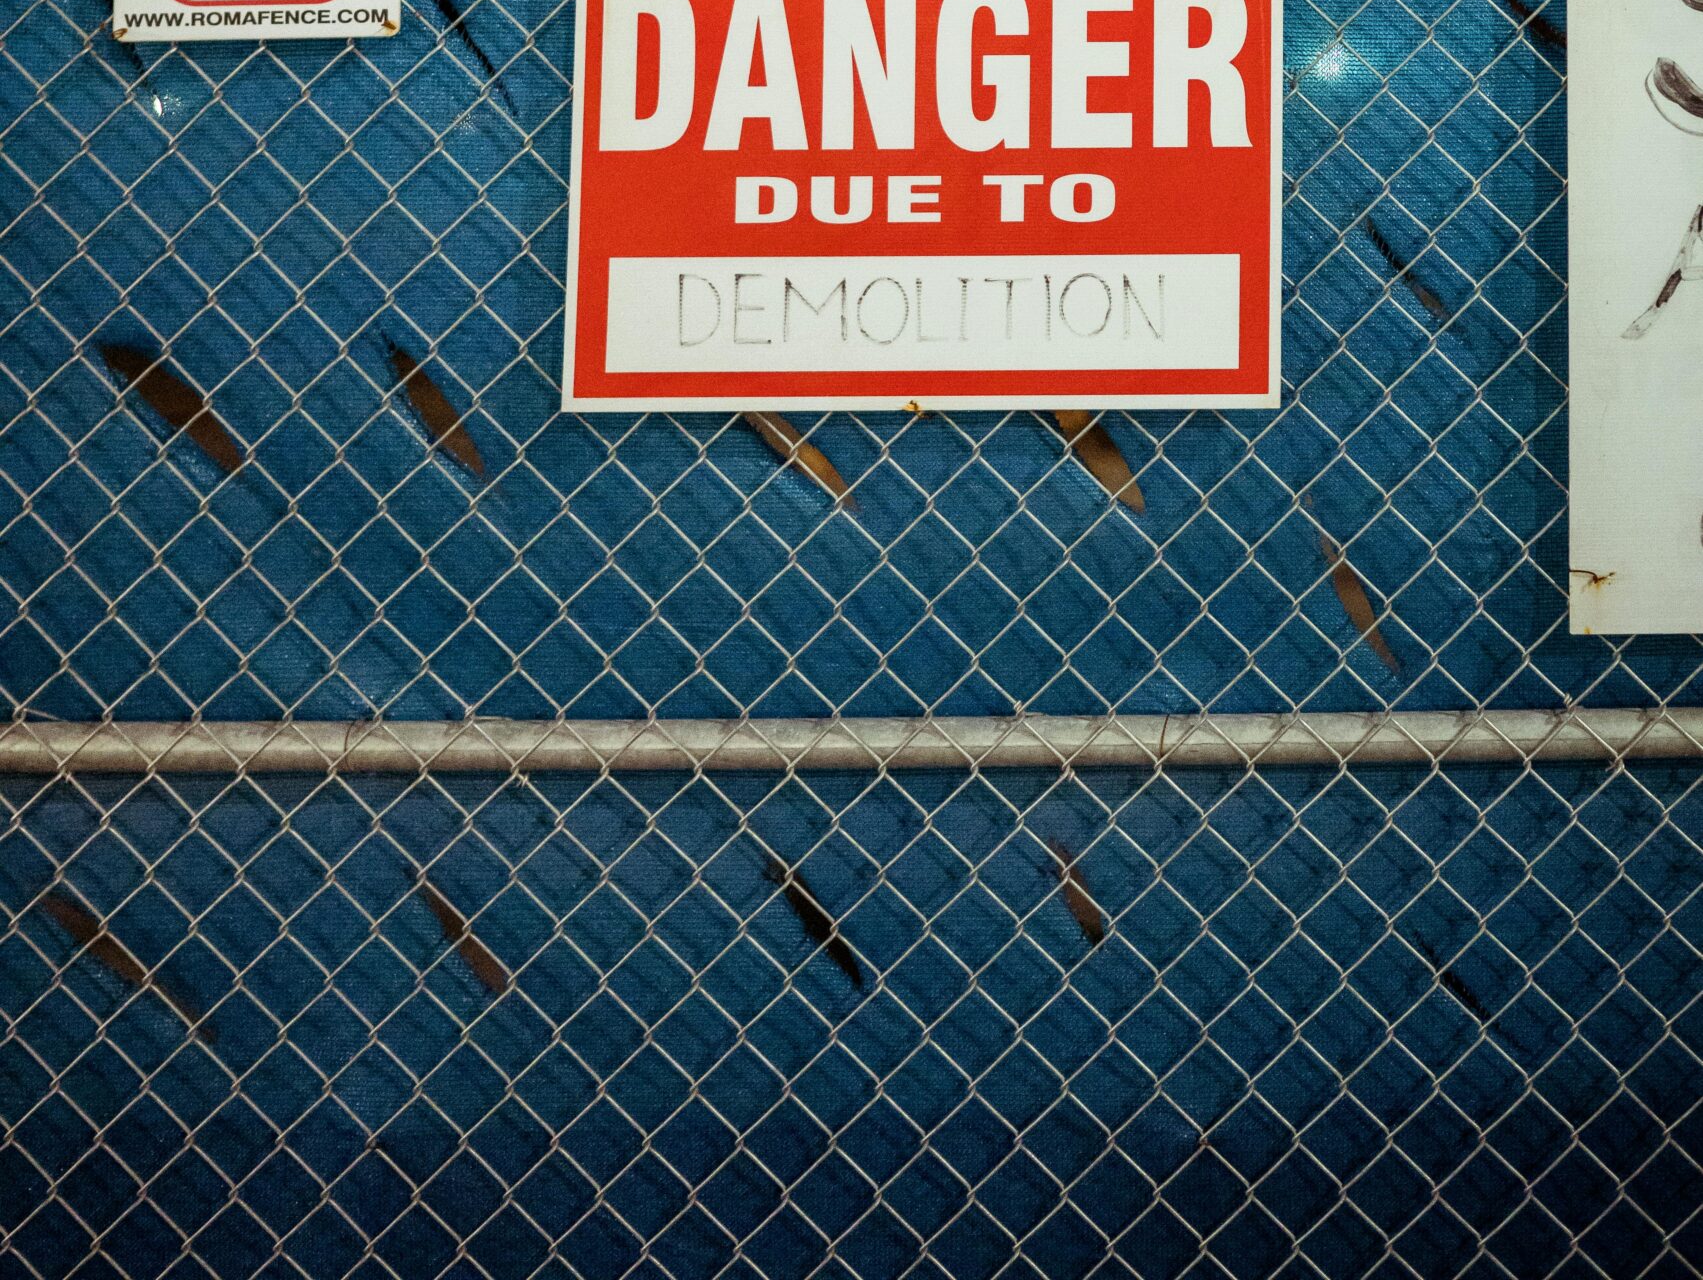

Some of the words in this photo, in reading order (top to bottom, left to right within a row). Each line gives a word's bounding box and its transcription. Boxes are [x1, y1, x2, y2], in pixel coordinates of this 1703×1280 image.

[124, 8, 389, 28] WWW.ROMAFENCE.COM
[734, 173, 942, 225] DUE
[982, 173, 1117, 223] TO
[678, 272, 1168, 348] DEMOLITION
